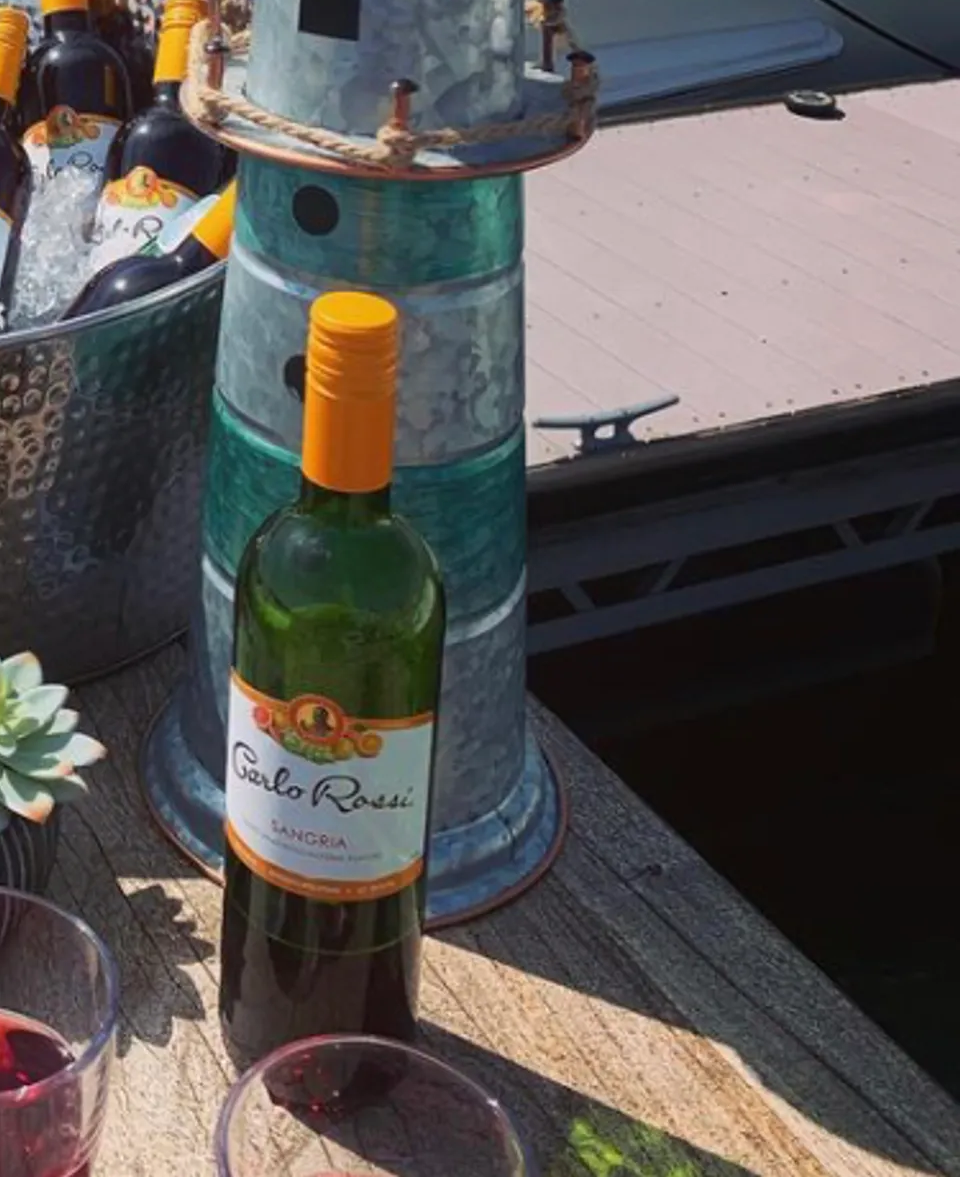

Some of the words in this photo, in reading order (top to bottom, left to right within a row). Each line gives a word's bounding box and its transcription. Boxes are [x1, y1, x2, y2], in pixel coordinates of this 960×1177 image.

[232, 741, 304, 801] Carlo
[311, 774, 415, 814] Rossi
[270, 819, 349, 850] SANGRIA
